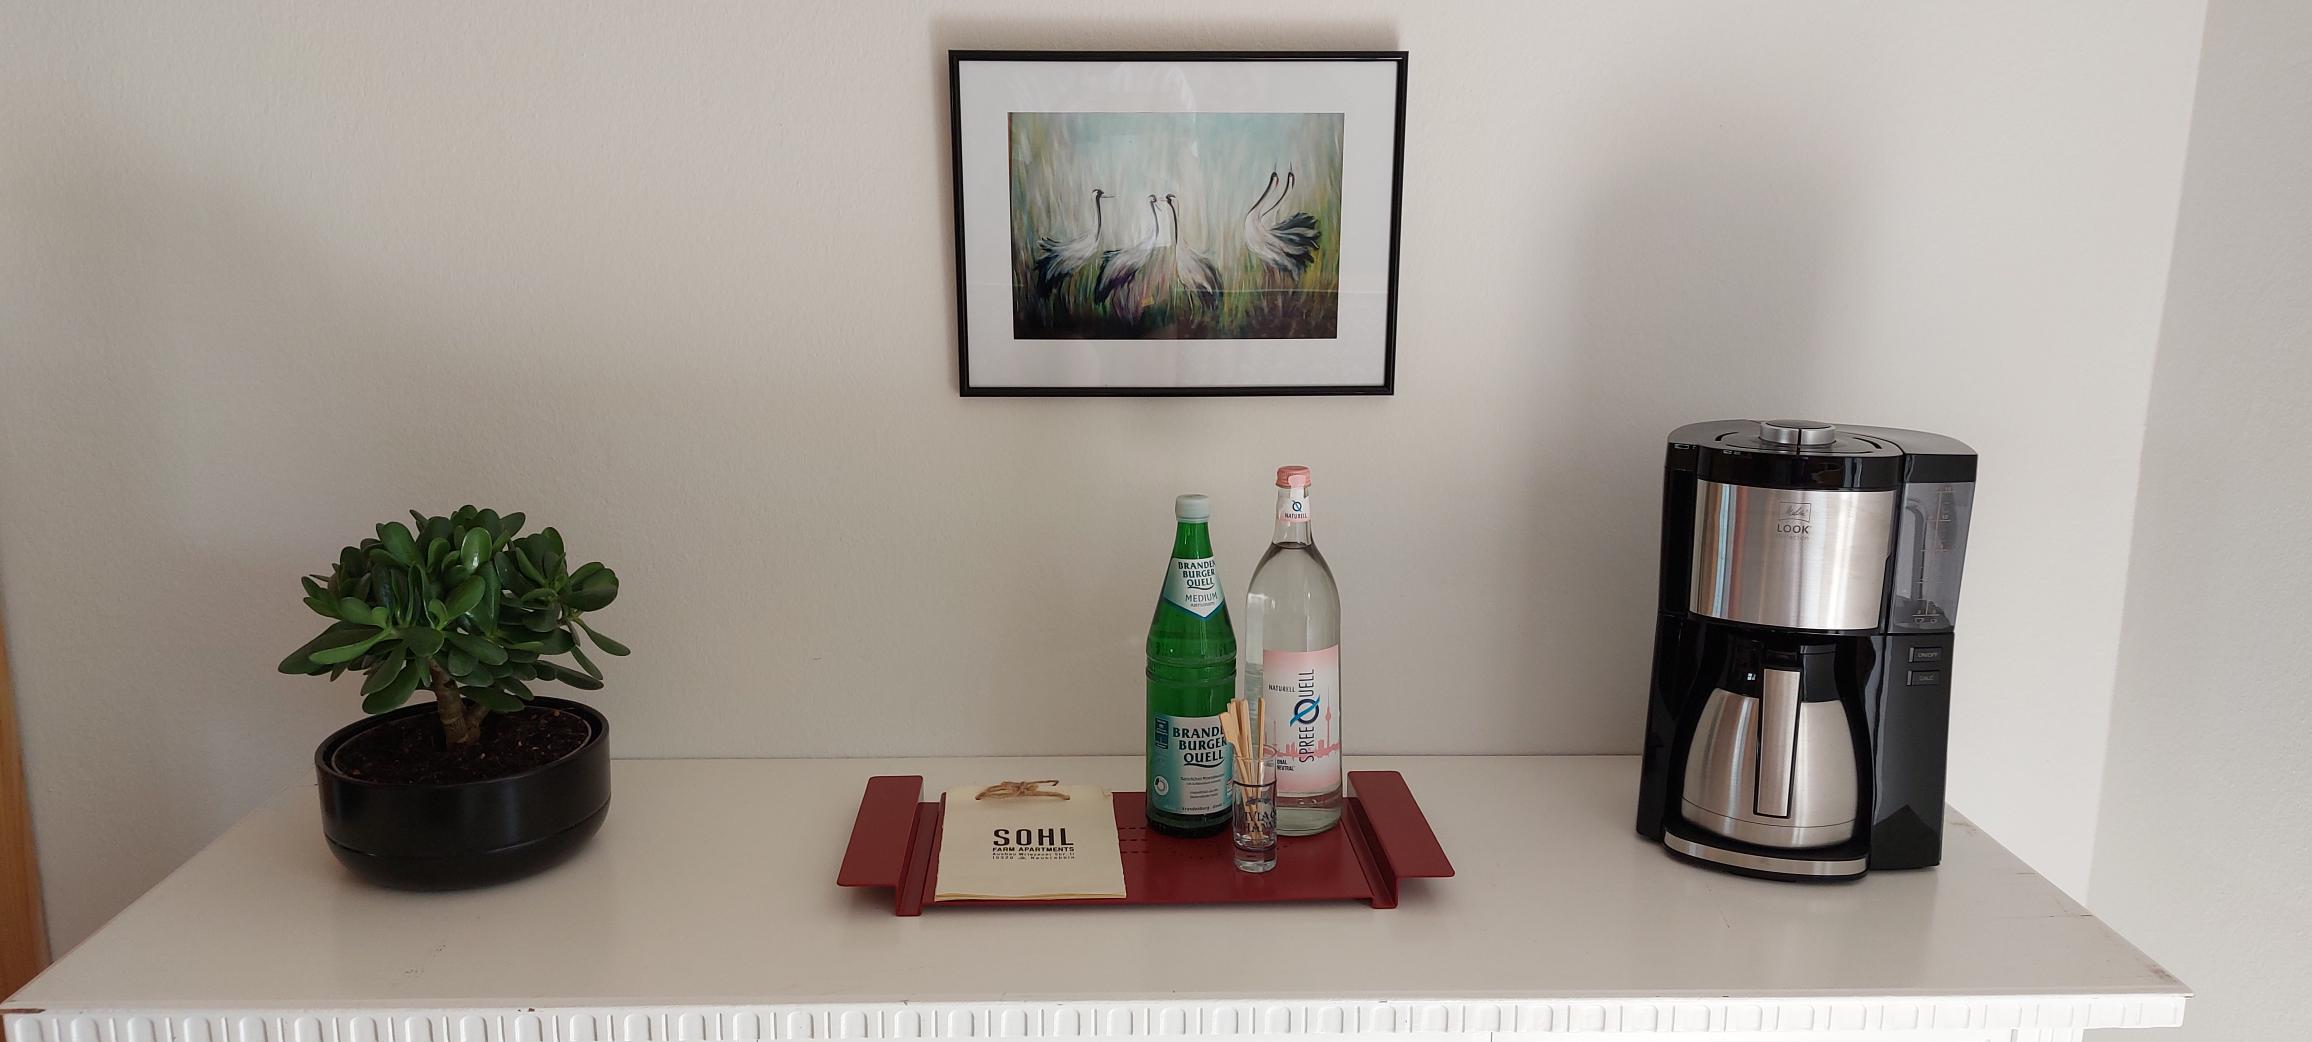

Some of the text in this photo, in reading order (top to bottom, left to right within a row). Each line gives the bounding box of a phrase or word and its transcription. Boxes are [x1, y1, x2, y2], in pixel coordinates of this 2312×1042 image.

[1777, 523, 1809, 534] LOOK
[1182, 568, 1216, 578] BURGER
[1186, 577, 1215, 590] QUELL
[1185, 592, 1218, 602] MEDIUM
[1268, 684, 1295, 692] NATURELL
[1183, 749, 1225, 768] QUELL
[993, 827, 1074, 846] SOHL
